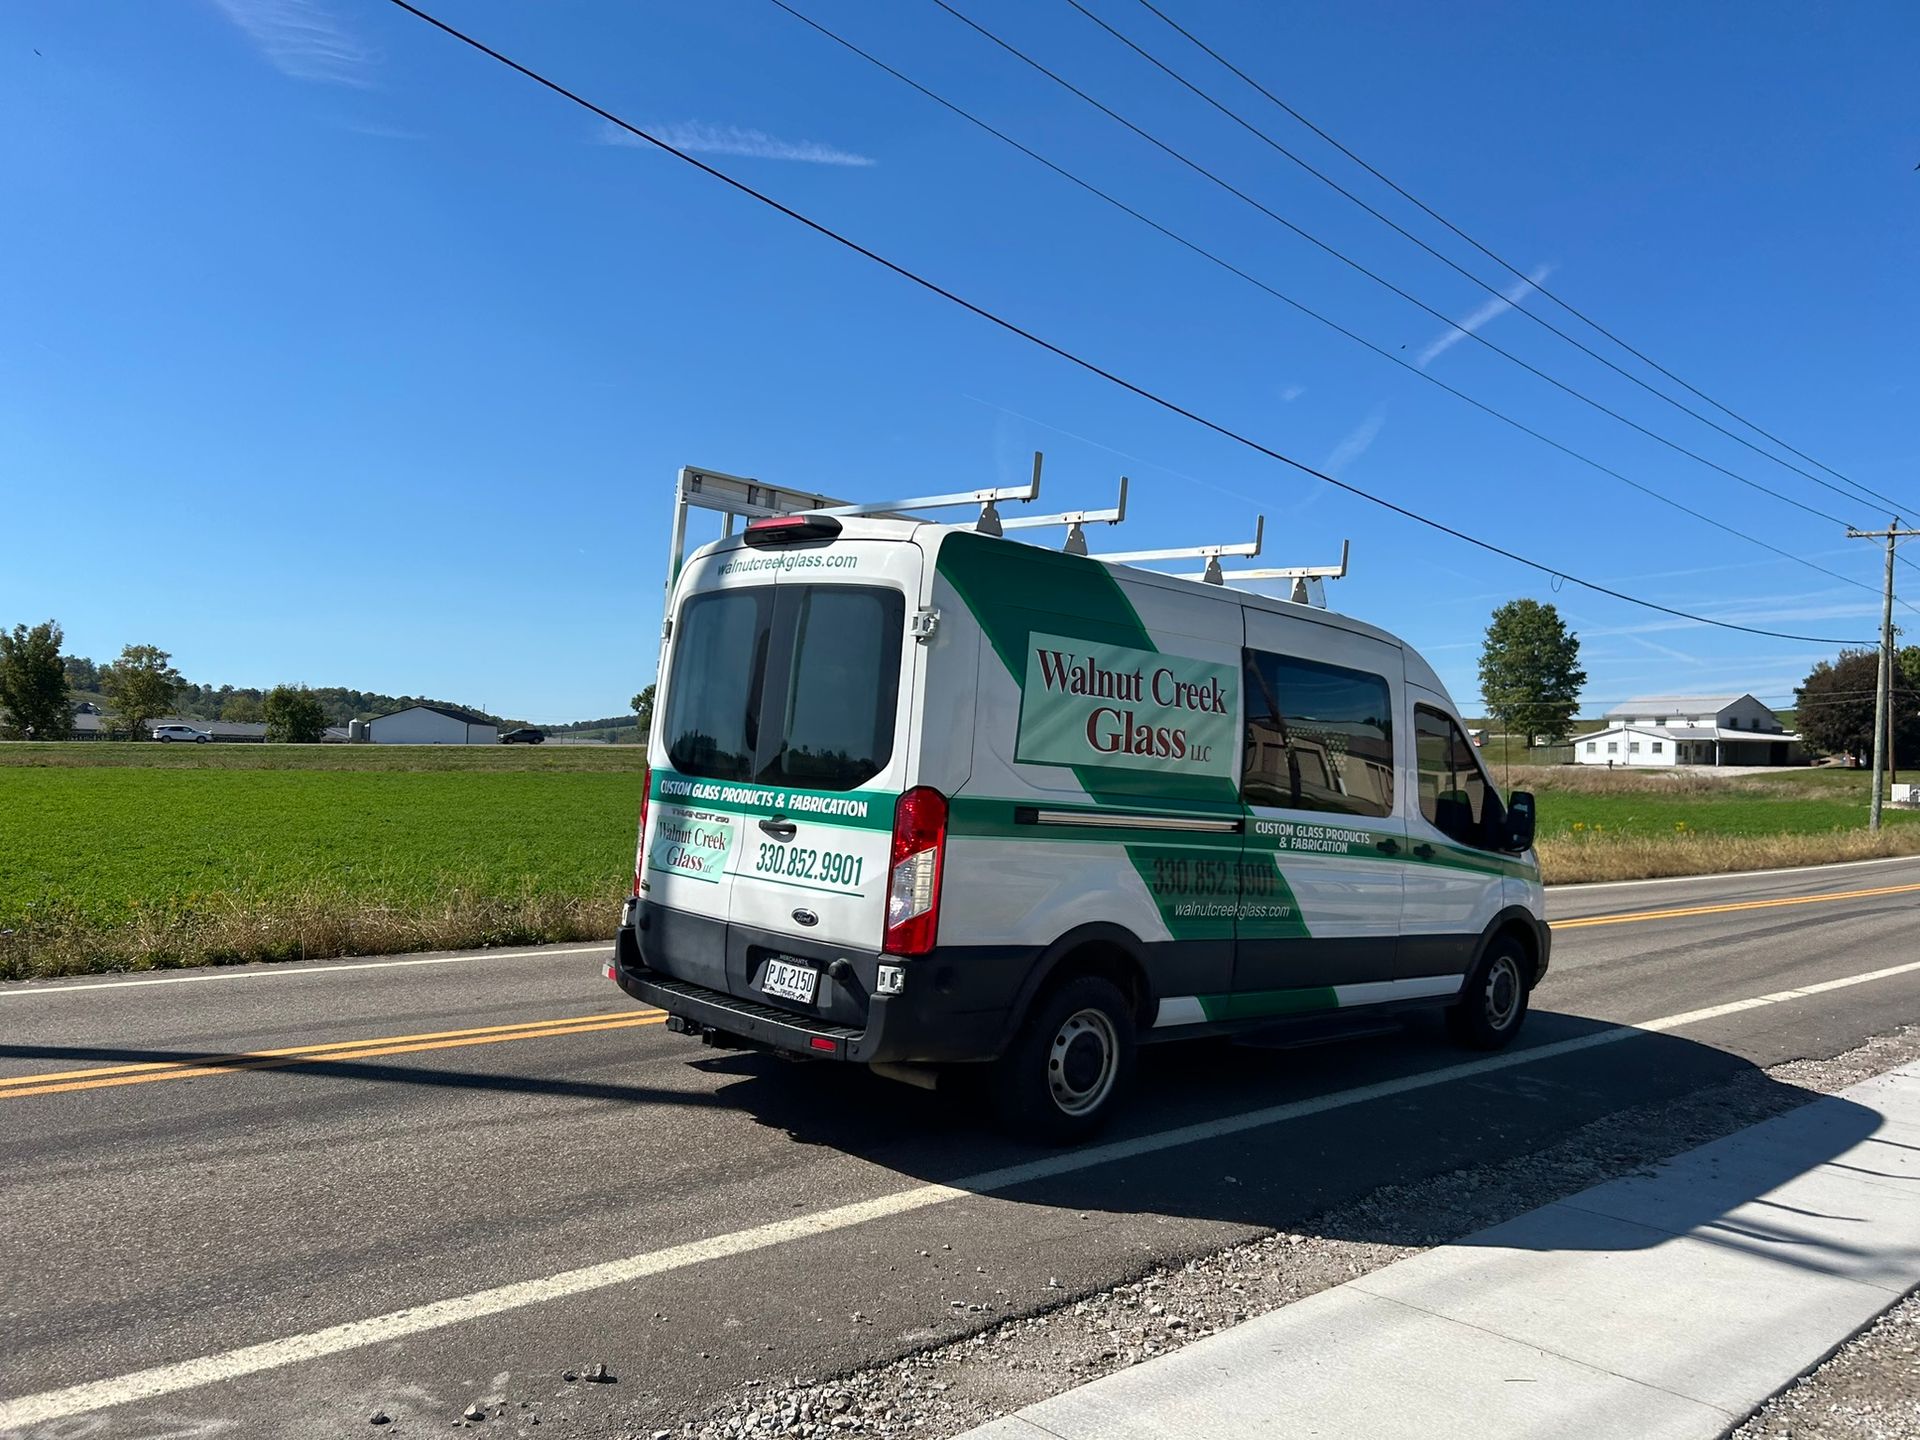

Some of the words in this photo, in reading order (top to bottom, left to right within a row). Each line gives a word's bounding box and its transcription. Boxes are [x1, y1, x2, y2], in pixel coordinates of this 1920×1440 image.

[718, 552, 858, 576] walnutcreekglass.com
[1036, 648, 1144, 702] Walnut
[1151, 668, 1228, 715] Creek
[1086, 707, 1187, 760] Glass
[1190, 744, 1212, 762] LLC
[660, 779, 692, 796] CUSTOM
[692, 783, 720, 800] GLASS
[720, 789, 774, 807] PRODUCTS
[775, 793, 785, 807] &
[788, 795, 868, 818] FABRICATION
[660, 821, 692, 844] Walnut
[694, 827, 727, 851] Creek
[1255, 821, 1294, 837] CUSTOM
[1296, 824, 1324, 840] GLASS
[1325, 827, 1370, 844] PRODUCTS
[1279, 836, 1287, 849] &
[1290, 838, 1348, 853] FABRICATION
[666, 845, 704, 872] Glass
[756, 842, 864, 886] 330.852.9901
[1175, 901, 1290, 921] walnutcreekglass.com
[767, 964, 788, 985] PJG
[788, 969, 815, 992] 2150
